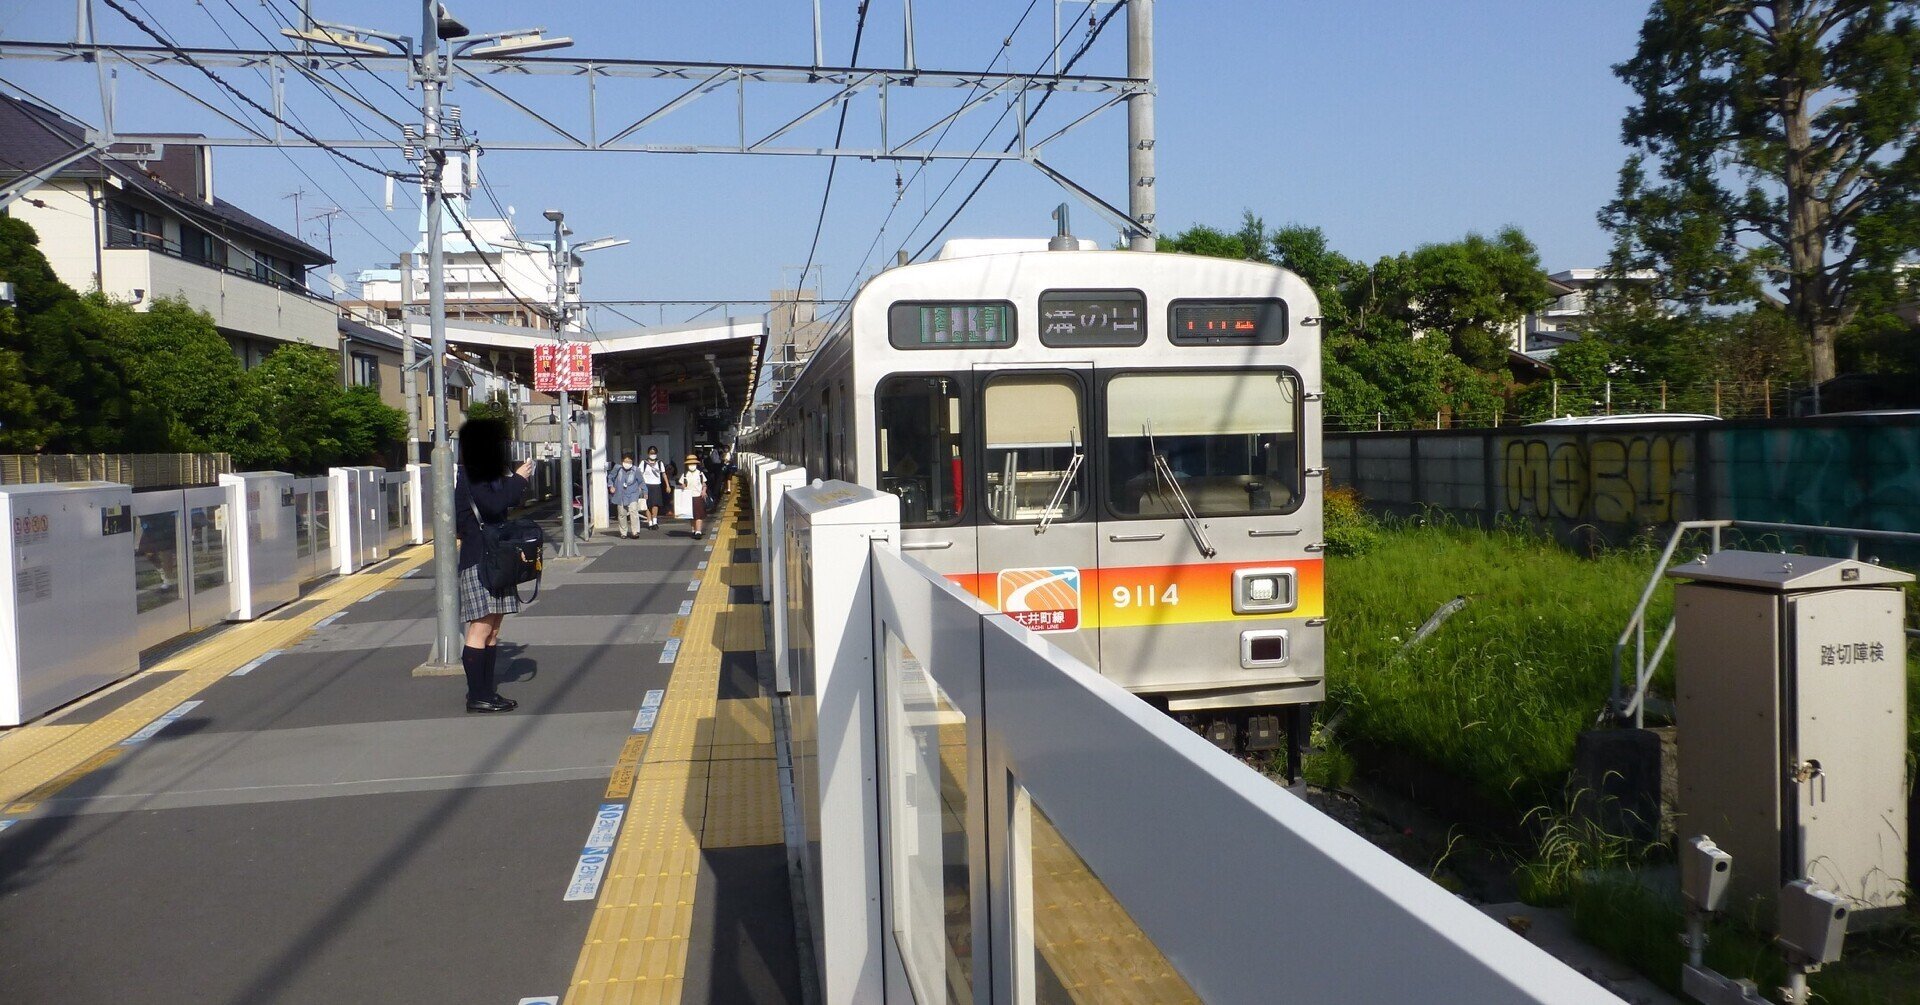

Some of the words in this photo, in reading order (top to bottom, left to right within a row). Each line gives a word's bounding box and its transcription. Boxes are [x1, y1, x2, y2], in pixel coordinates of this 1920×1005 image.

[1112, 583, 1180, 608] 9114
[1015, 611, 1065, 625] 大井町線
[1820, 641, 1885, 666] 踏切障検
